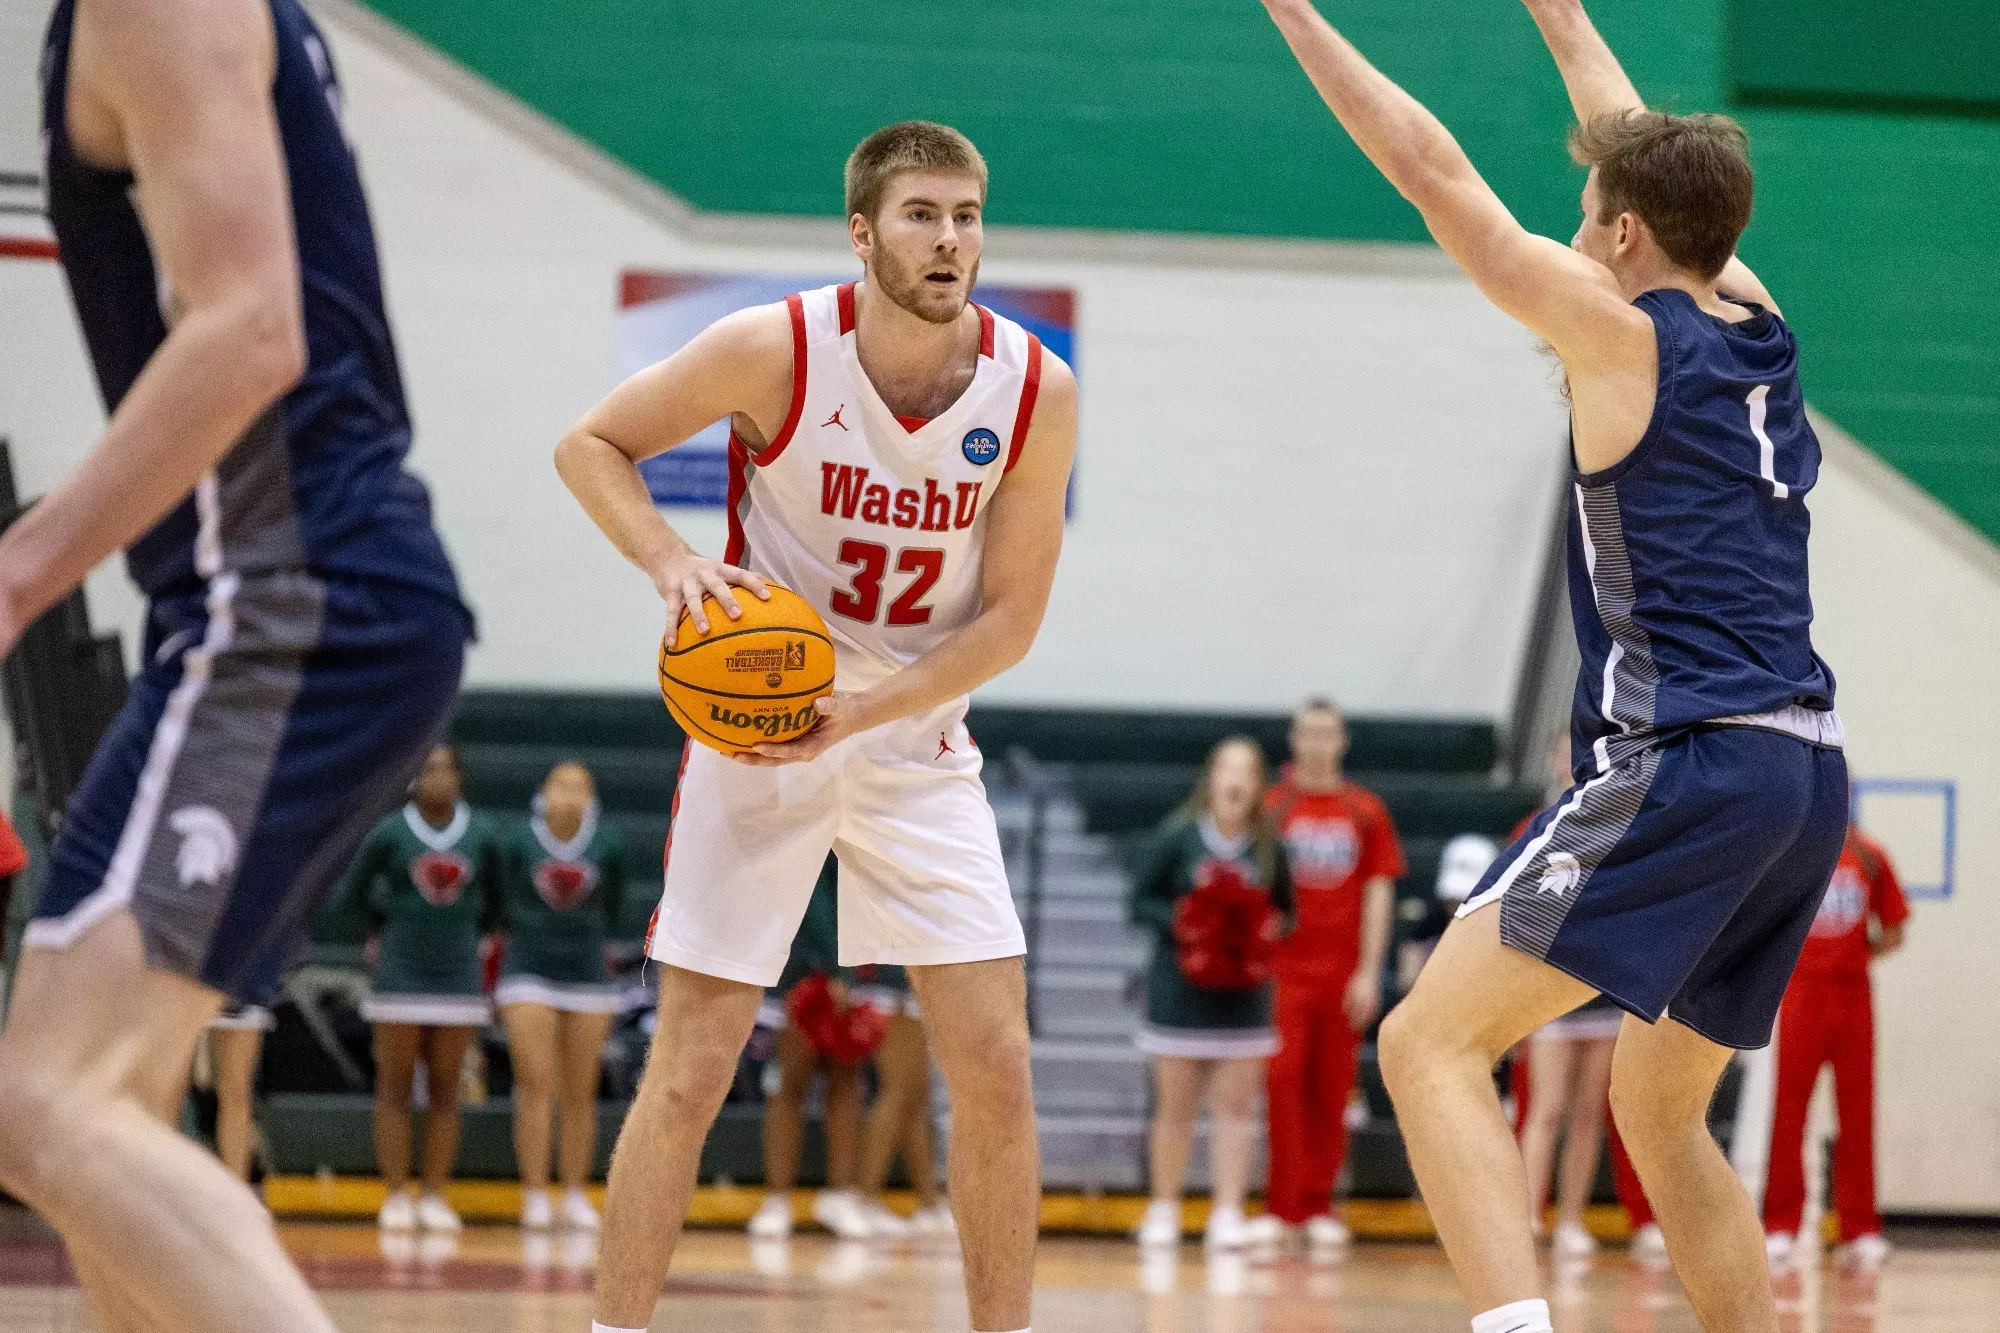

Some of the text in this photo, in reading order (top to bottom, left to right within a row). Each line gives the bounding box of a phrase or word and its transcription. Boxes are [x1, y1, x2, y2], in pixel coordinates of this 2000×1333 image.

[1745, 384, 1789, 499] 1
[820, 460, 983, 532] WashU
[829, 536, 946, 627] 32
[725, 656, 783, 668] BASKETBALL
[735, 648, 784, 657] CHAMPIONSHIP
[711, 704, 818, 737] Wilson
